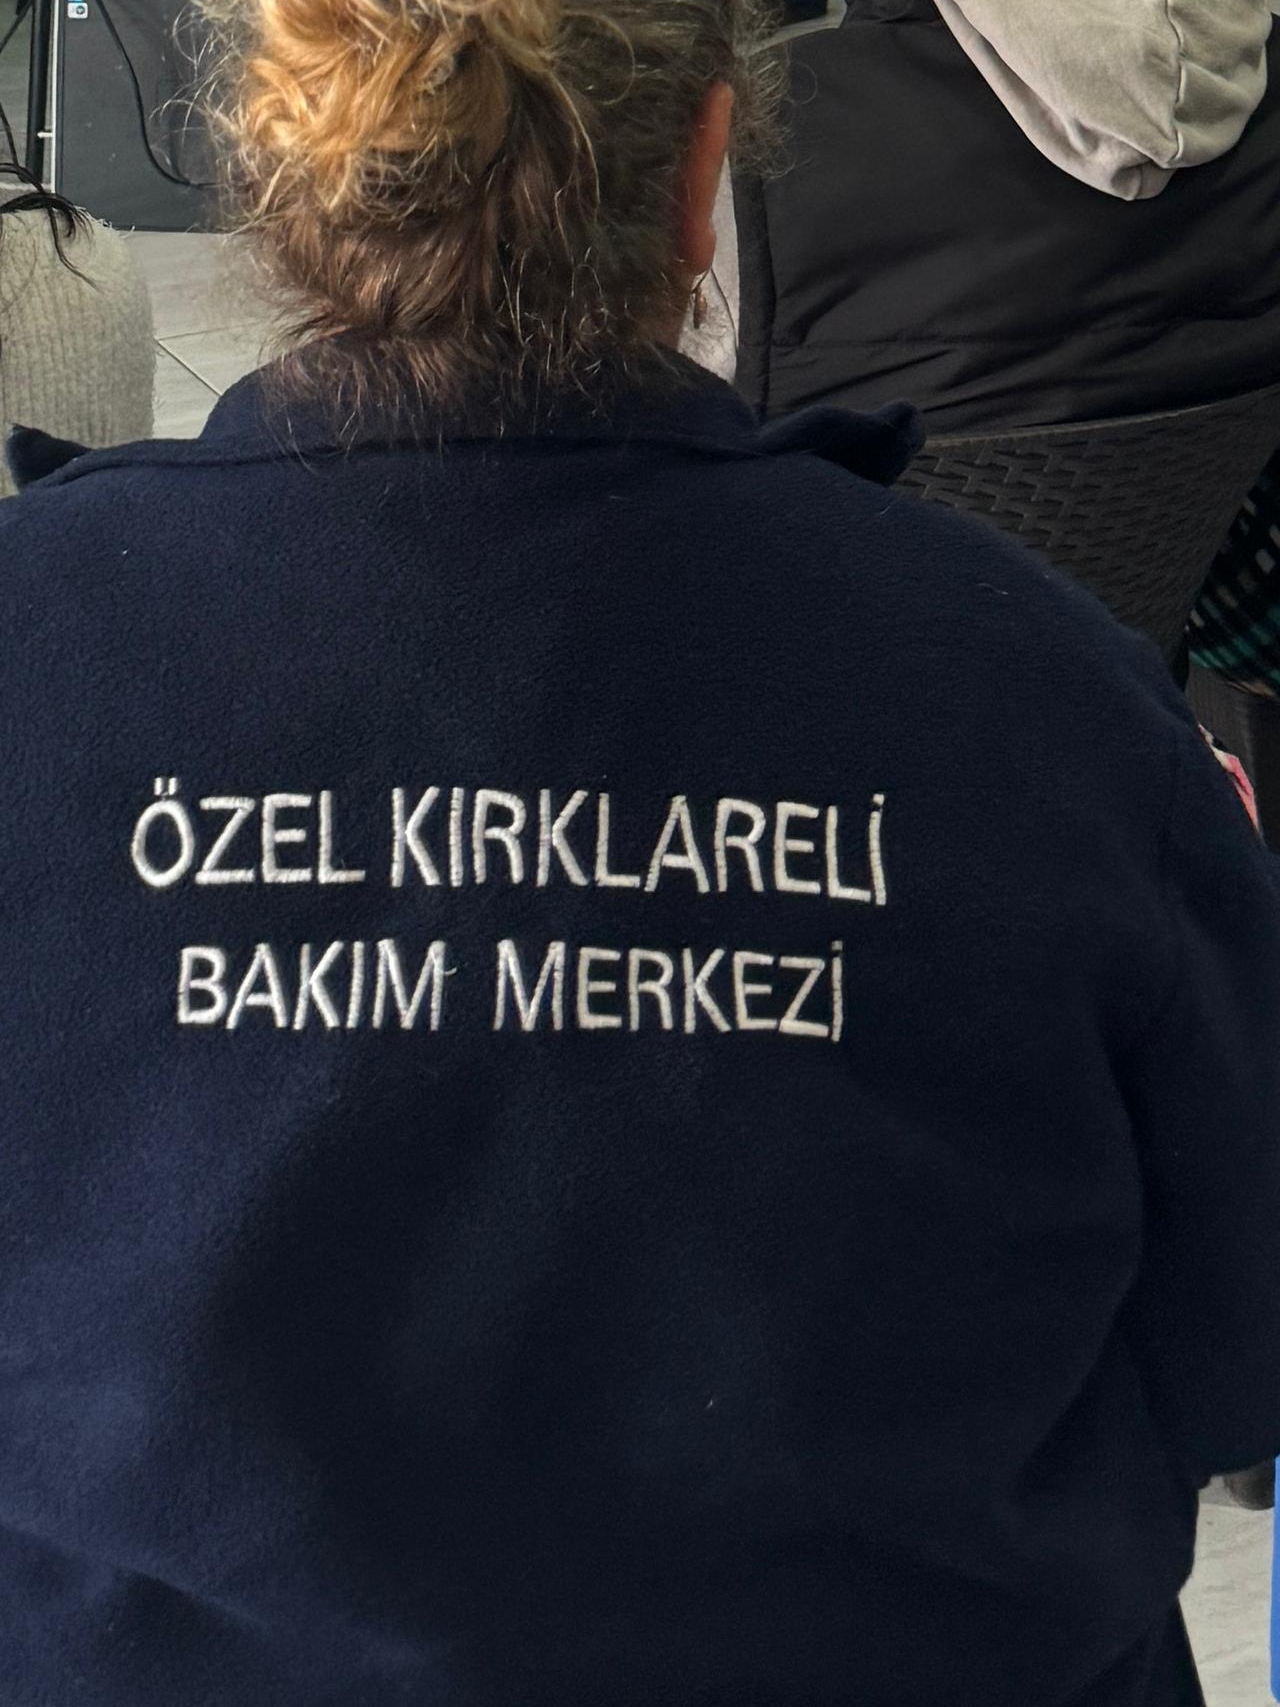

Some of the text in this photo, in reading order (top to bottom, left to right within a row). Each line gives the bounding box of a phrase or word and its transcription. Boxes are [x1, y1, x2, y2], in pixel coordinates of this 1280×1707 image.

[130, 777, 888, 906] ÖZEL KIRKLARELİ
[176, 939, 846, 1042] BAKIM MERKEZİ
